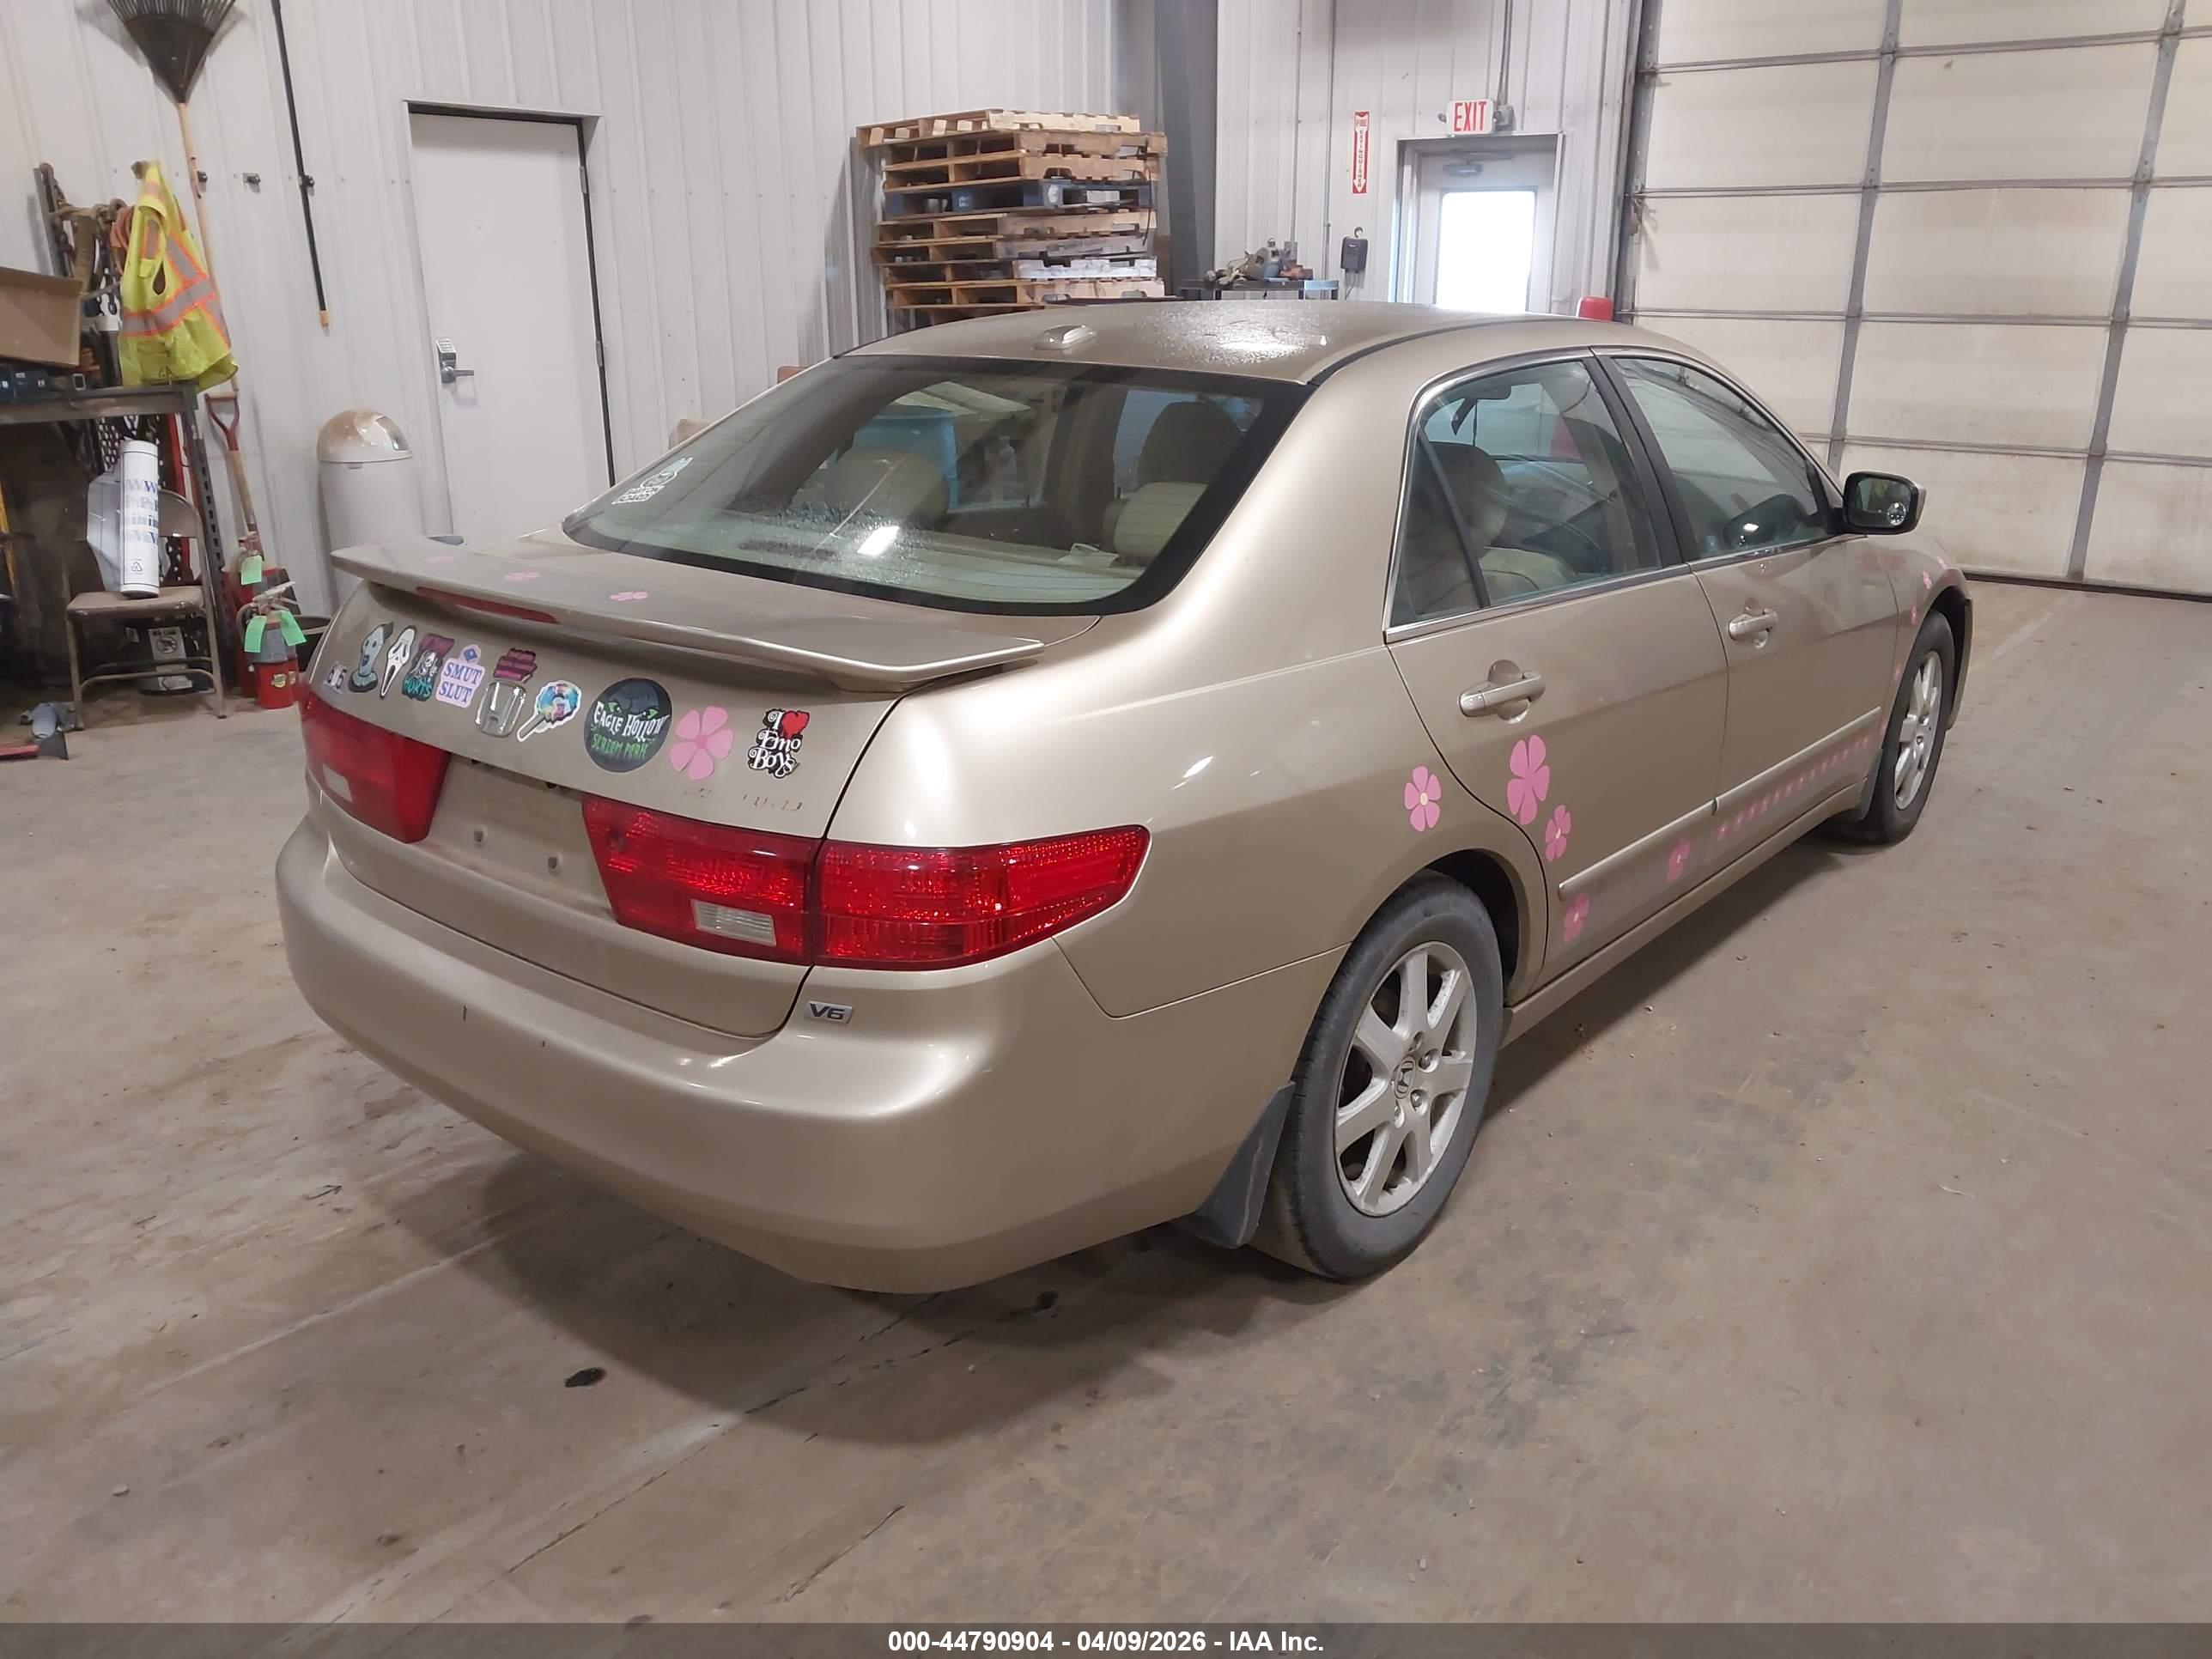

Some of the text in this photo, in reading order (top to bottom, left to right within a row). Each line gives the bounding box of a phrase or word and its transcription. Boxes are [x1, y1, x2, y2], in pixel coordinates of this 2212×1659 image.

[1453, 100, 1487, 132] EXIT
[443, 661, 483, 684] SMUT
[439, 680, 472, 703] SLUT
[593, 701, 671, 743] EAGLE HOLLOW
[767, 710, 785, 730] I
[757, 729, 801, 752] Emo
[749, 746, 797, 777] Boys
[810, 1003, 845, 1020] V6
